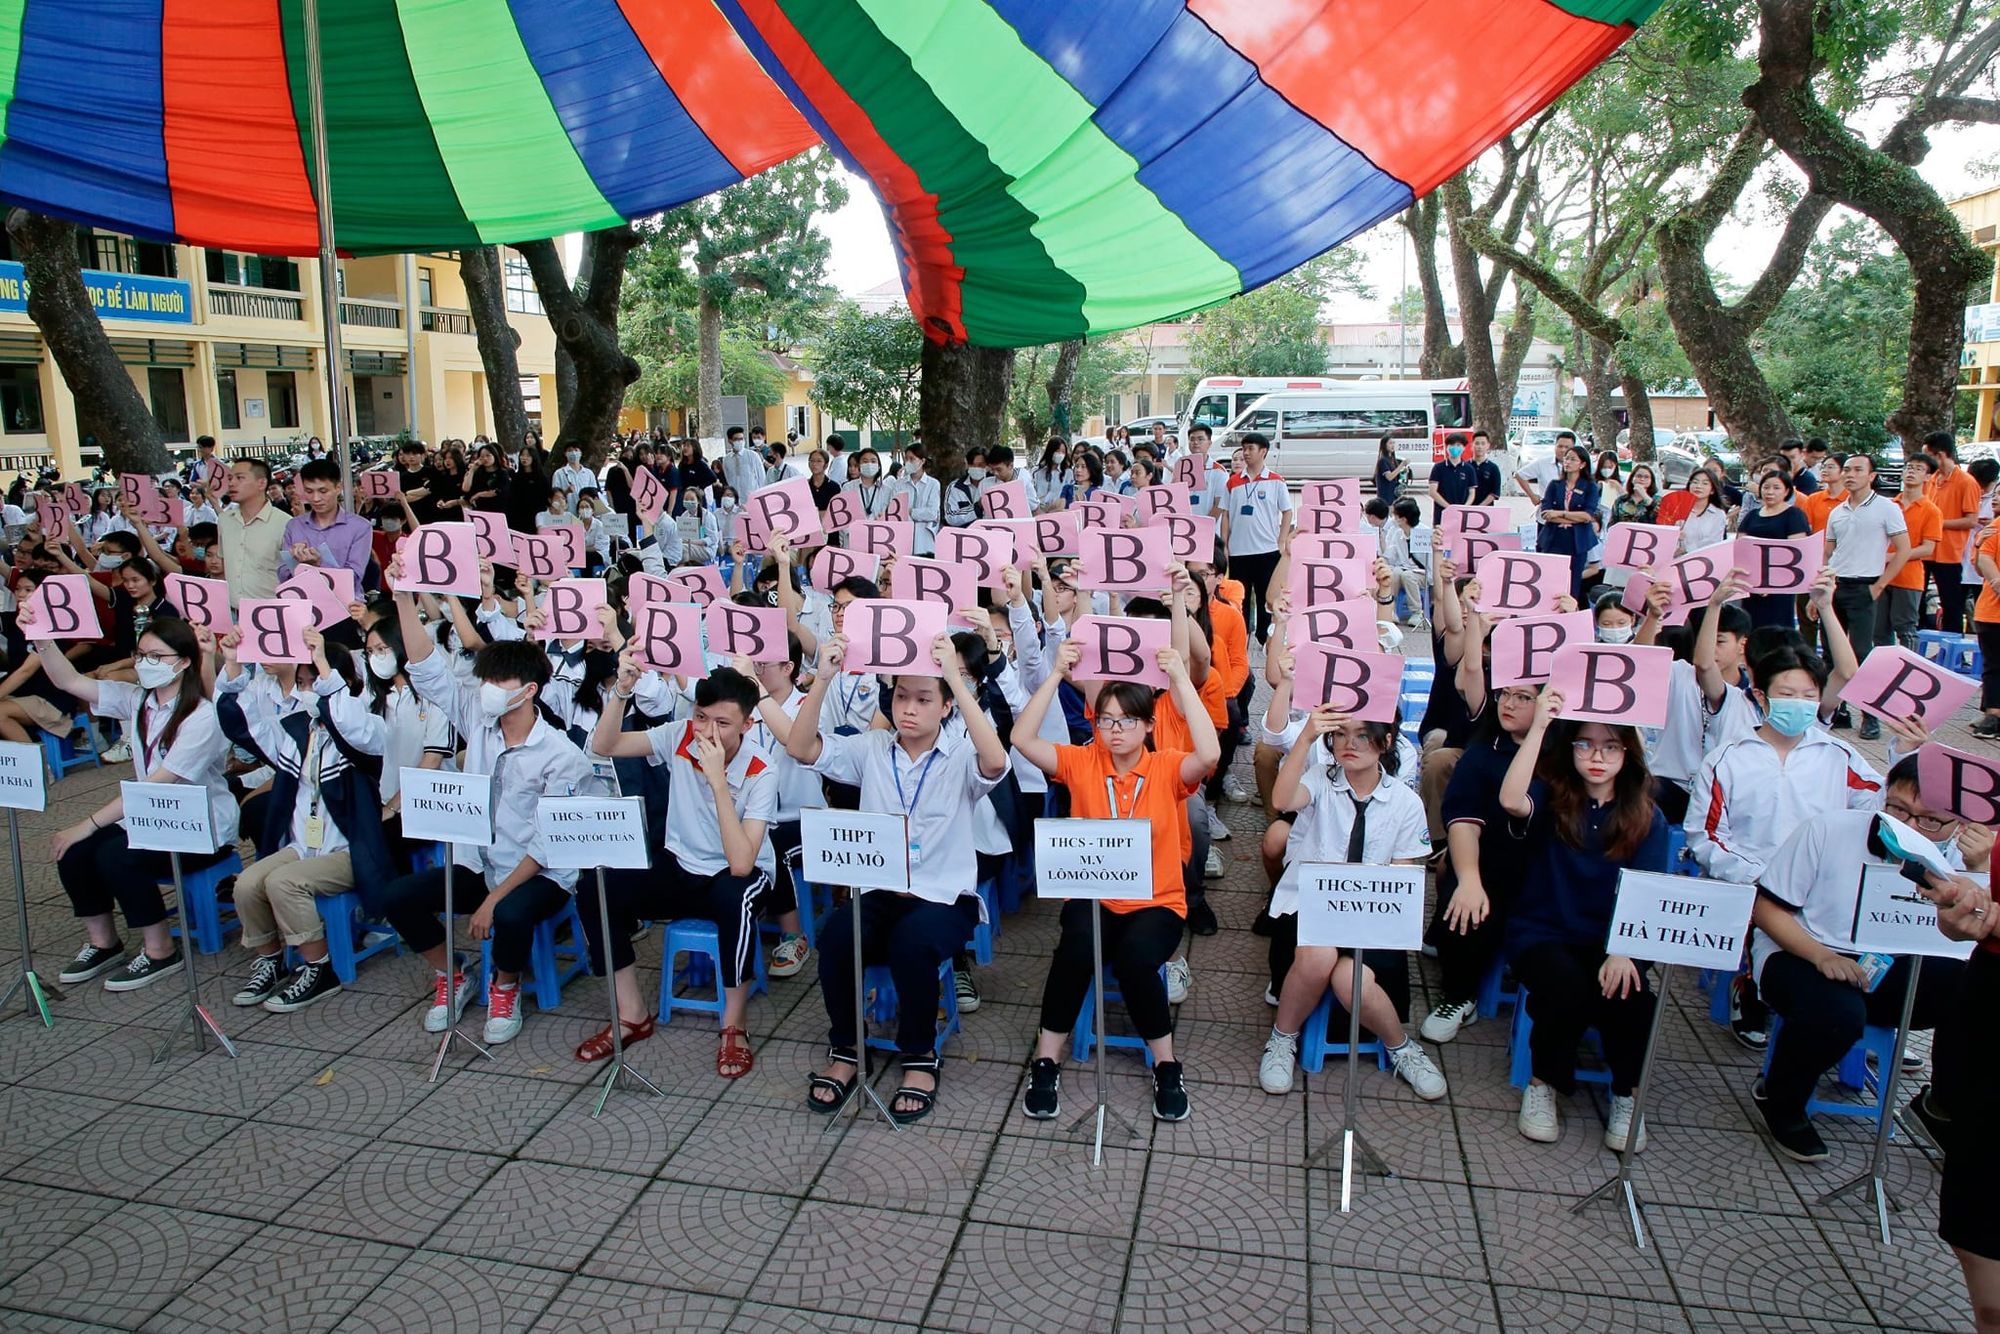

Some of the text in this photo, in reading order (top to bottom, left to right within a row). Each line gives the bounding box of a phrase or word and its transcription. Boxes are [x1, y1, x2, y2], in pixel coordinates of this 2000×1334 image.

[107, 281, 123, 309] ĐỂ
[125, 286, 149, 311] LÀM
[151, 289, 184, 314] NGƯỜI
[210, 462, 226, 491] B
[371, 474, 390, 496] B
[1180, 458, 1196, 489] B
[65, 486, 80, 511] B
[122, 476, 141, 507] B
[639, 471, 658, 511] B
[48, 506, 64, 540] B
[755, 491, 799, 537] B
[829, 497, 852, 528] B
[468, 514, 496, 558] B
[1036, 519, 1065, 552] B
[1164, 516, 1197, 556] B
[1617, 528, 1659, 568] B
[416, 529, 458, 586] B
[526, 538, 554, 576] B
[950, 533, 990, 581] B
[1097, 532, 1147, 584] B
[1753, 543, 1806, 590] B
[1492, 557, 1542, 609] B
[1671, 557, 1722, 606] B
[42, 581, 80, 633] B
[176, 579, 212, 627] B
[550, 586, 588, 634] B
[644, 607, 682, 668] B
[720, 606, 765, 656] B
[865, 604, 918, 668] B
[1092, 622, 1145, 676] B
[1314, 650, 1371, 714] B
[1572, 650, 1637, 715] B
[1863, 656, 1942, 723] B
[7, 775, 33, 788] KHAI
[430, 782, 464, 796] THPT
[1941, 752, 2000, 826] B
[148, 797, 181, 810] THPT
[411, 797, 454, 813] TRUNG
[550, 811, 584, 823] THCS
[595, 810, 627, 821] THPT
[129, 816, 204, 832] THƯỢNG CÁT
[829, 827, 875, 845] THPT
[821, 849, 853, 866] ĐẠI
[1049, 837, 1086, 848] THCS
[1096, 837, 1133, 848] THPT
[1079, 854, 1104, 865] M.V
[1315, 878, 1416, 895] THCS-THPT
[1327, 900, 1402, 914] NEWTON
[1658, 898, 1709, 918] THPT
[1867, 909, 1912, 926] XUÂN
[1618, 919, 1734, 952] HÀ THÀNH
